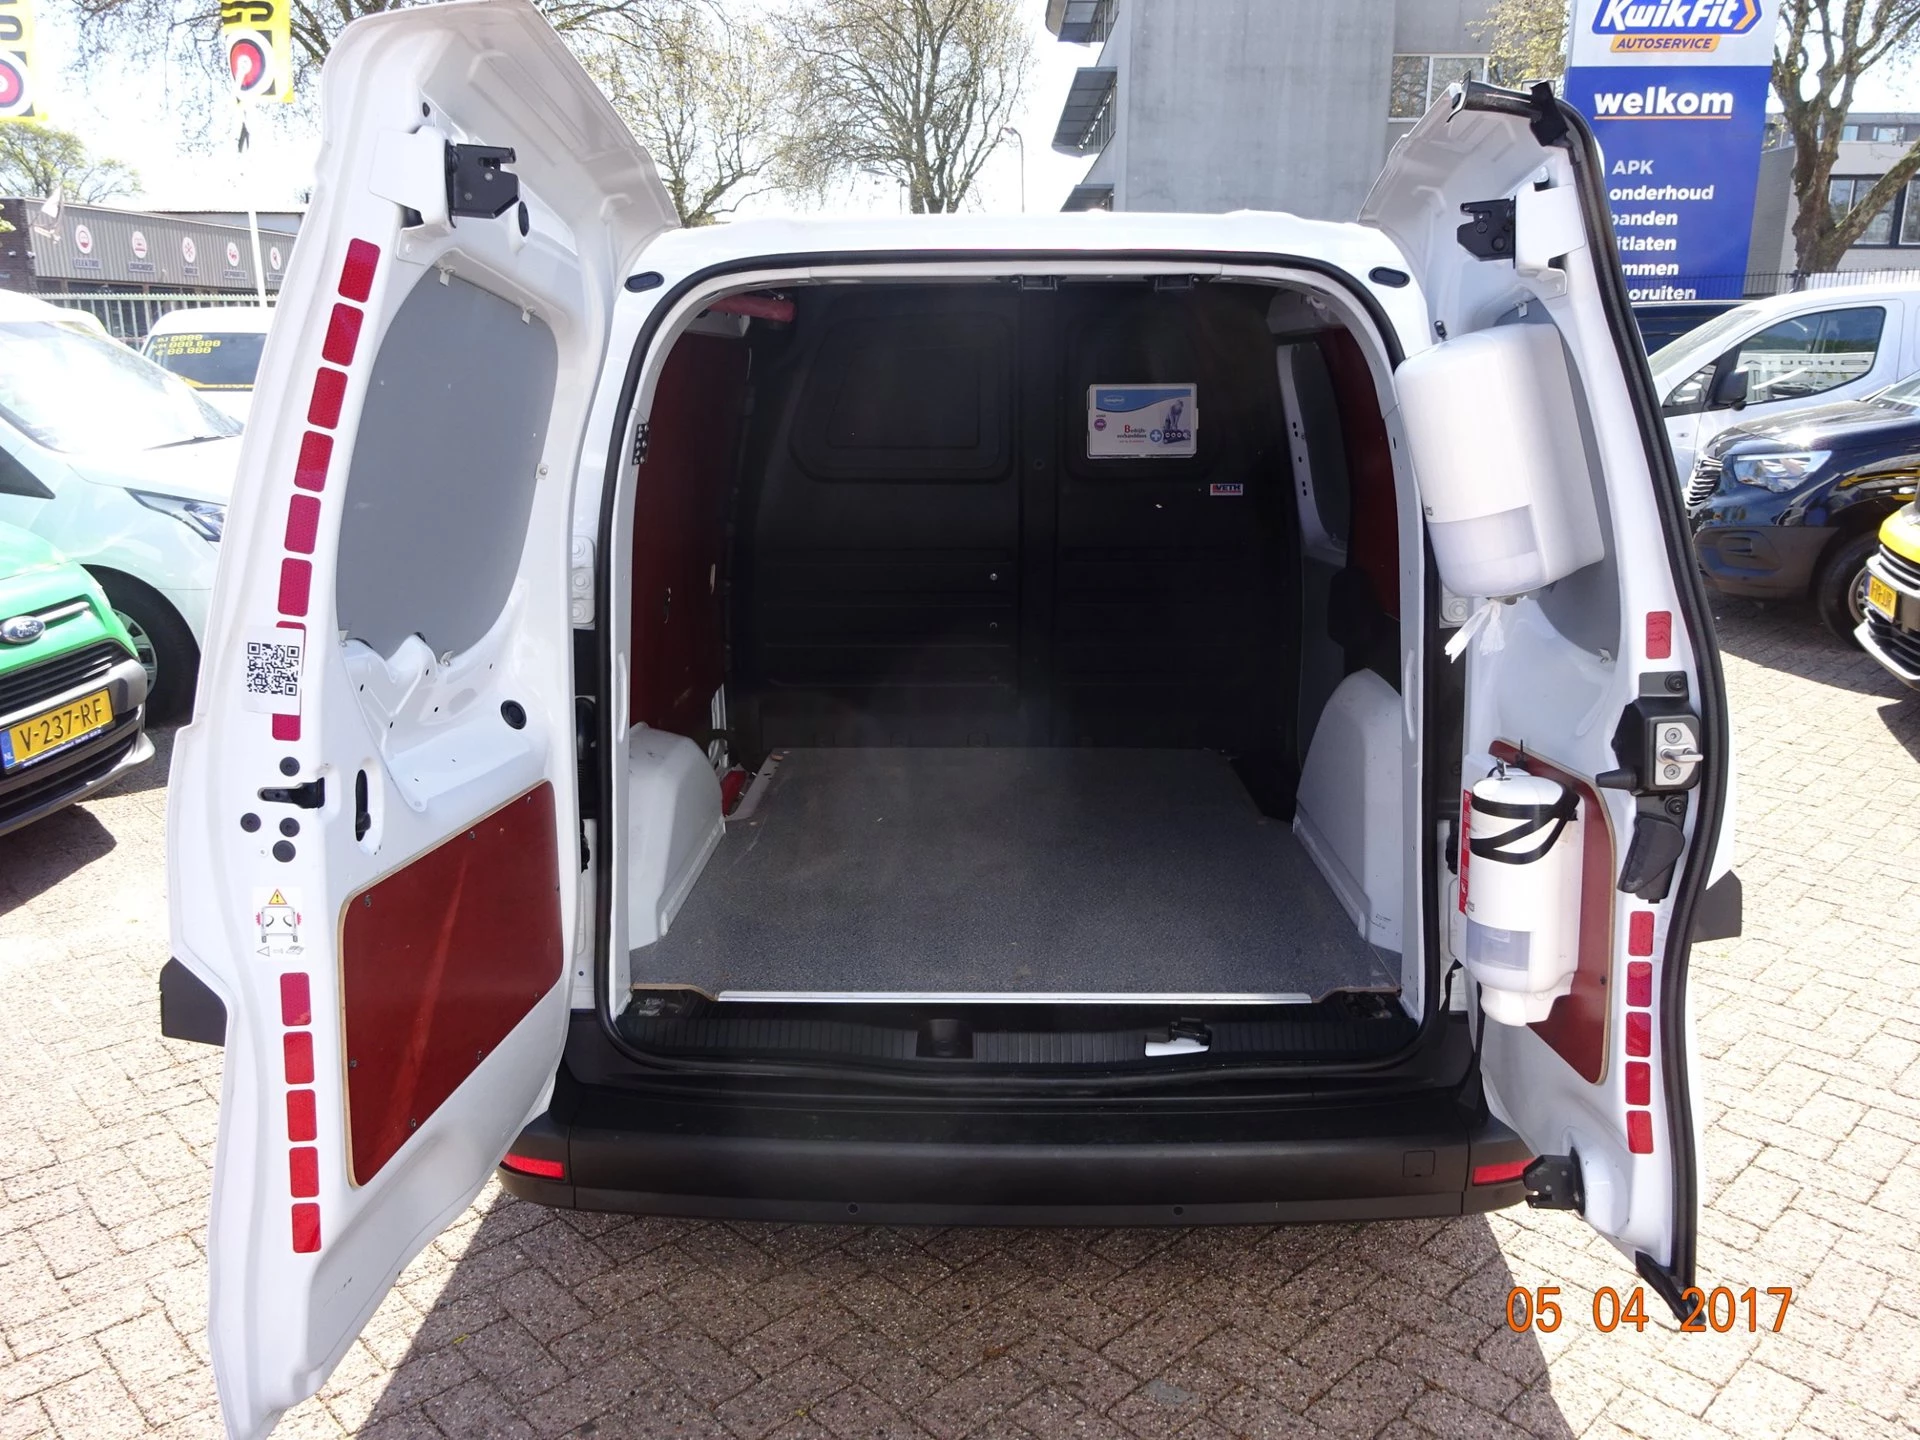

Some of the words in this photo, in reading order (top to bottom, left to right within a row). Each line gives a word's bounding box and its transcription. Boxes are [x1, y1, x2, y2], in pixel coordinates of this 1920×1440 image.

[1617, 38, 1713, 49] AUTOSERVICE
[1594, 87, 1733, 114] welkom
[1612, 160, 1654, 175] APK
[1609, 185, 1715, 200] onderhoud
[1617, 236, 1677, 251] itlaten
[1621, 263, 1679, 276] mmen
[1629, 285, 1696, 300] oruiten
[19, 698, 102, 752] V-237-RF
[3, 752, 14, 761] NL
